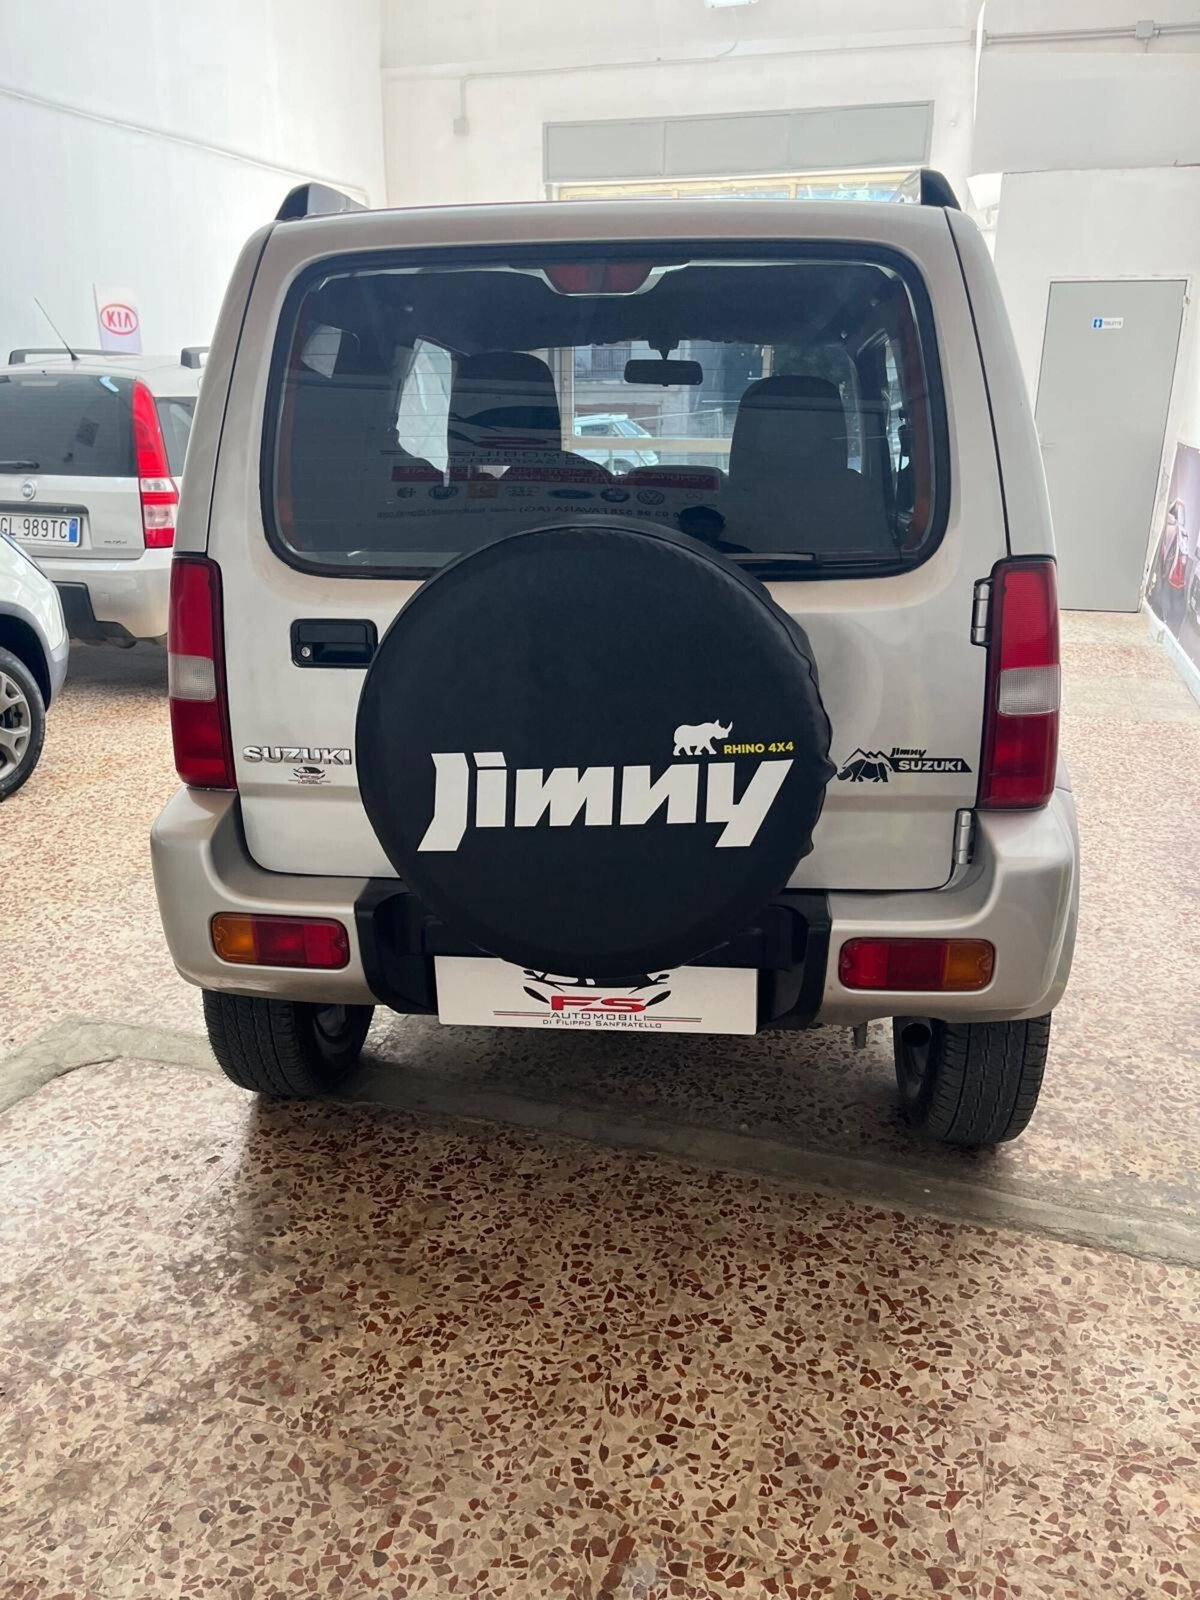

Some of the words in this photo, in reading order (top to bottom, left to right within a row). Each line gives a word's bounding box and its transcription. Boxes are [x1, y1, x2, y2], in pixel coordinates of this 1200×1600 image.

[106, 311, 133, 327] KIA
[23, 518, 68, 539] 989TC
[243, 746, 352, 765] SUZUKI
[723, 743, 765, 755] RHINO
[767, 741, 795, 753] 4X4
[898, 760, 963, 771] SUZUKI
[551, 995, 647, 1013] FS
[550, 1012, 647, 1022] AUTOMOBILI
[594, 1019, 663, 1029] SANFRATELLO
